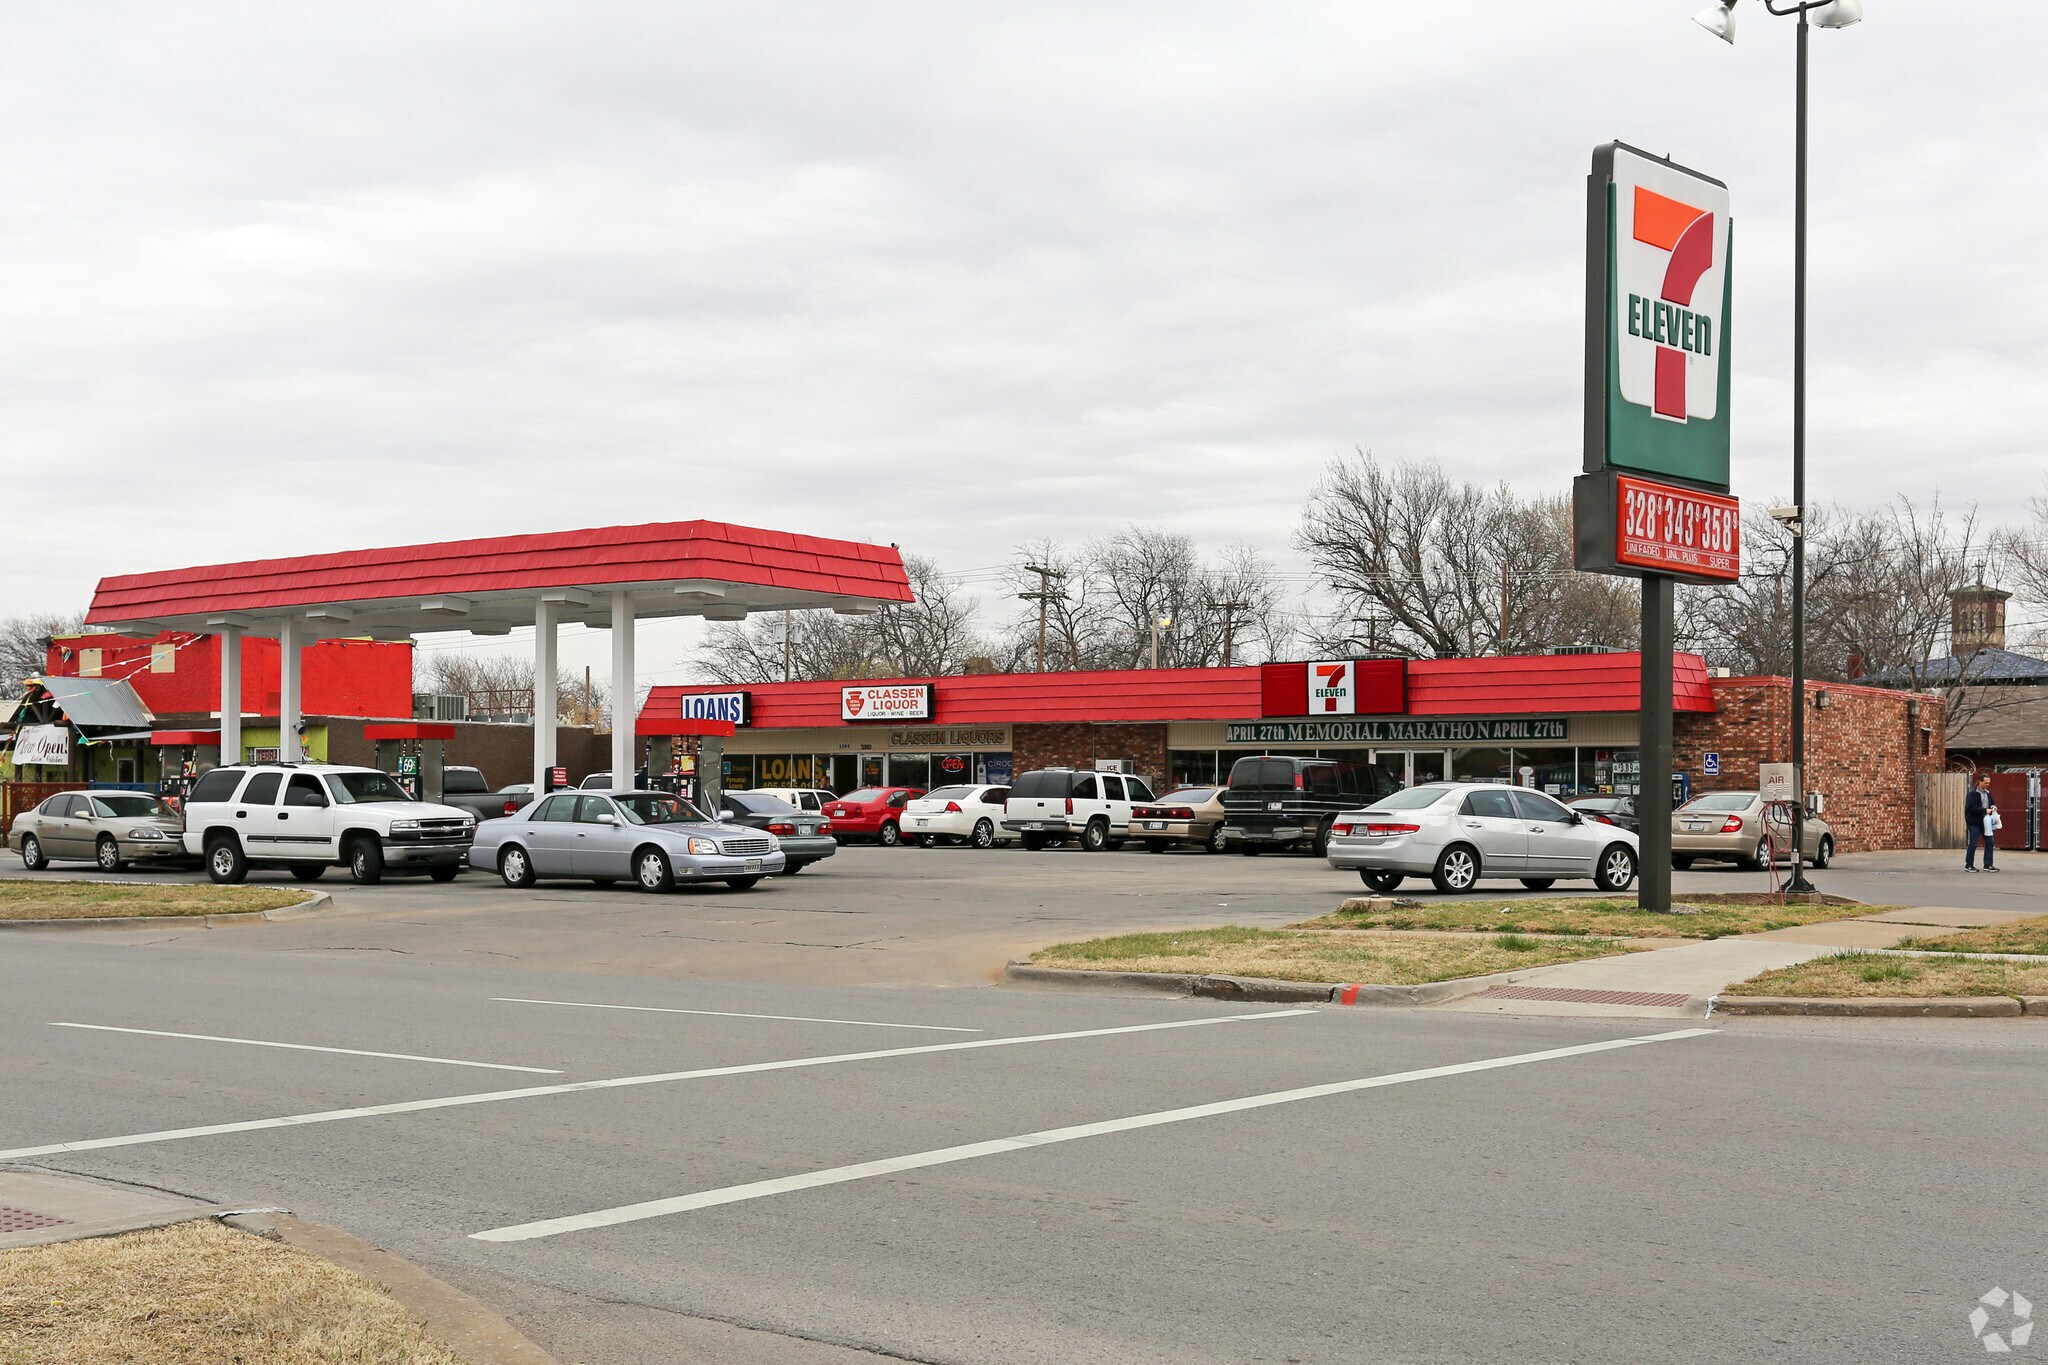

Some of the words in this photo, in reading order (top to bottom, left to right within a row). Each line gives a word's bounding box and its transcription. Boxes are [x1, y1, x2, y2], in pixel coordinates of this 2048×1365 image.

[1626, 542, 1661, 558] UNLEADED
[1682, 552, 1698, 564] PLUS
[1709, 556, 1730, 569] SUPER
[867, 688, 924, 699] CLASSEN
[685, 696, 741, 722] LOANS
[873, 699, 919, 710] LIQUOR
[891, 730, 946, 745] CLASSEN
[949, 729, 1005, 745] LIQUORS
[1227, 726, 1257, 741] APRIL
[1260, 725, 1285, 740] 27th
[1287, 723, 1383, 741] MEMORIAL
[1388, 721, 1490, 740] MARATHON
[1493, 723, 1530, 738] APRIL
[1534, 721, 1563, 737] 27th
[37, 734, 68, 758] Open!
[762, 759, 823, 780] LOANS
[942, 759, 964, 770] OPEN
[1769, 775, 1785, 784] AIR
